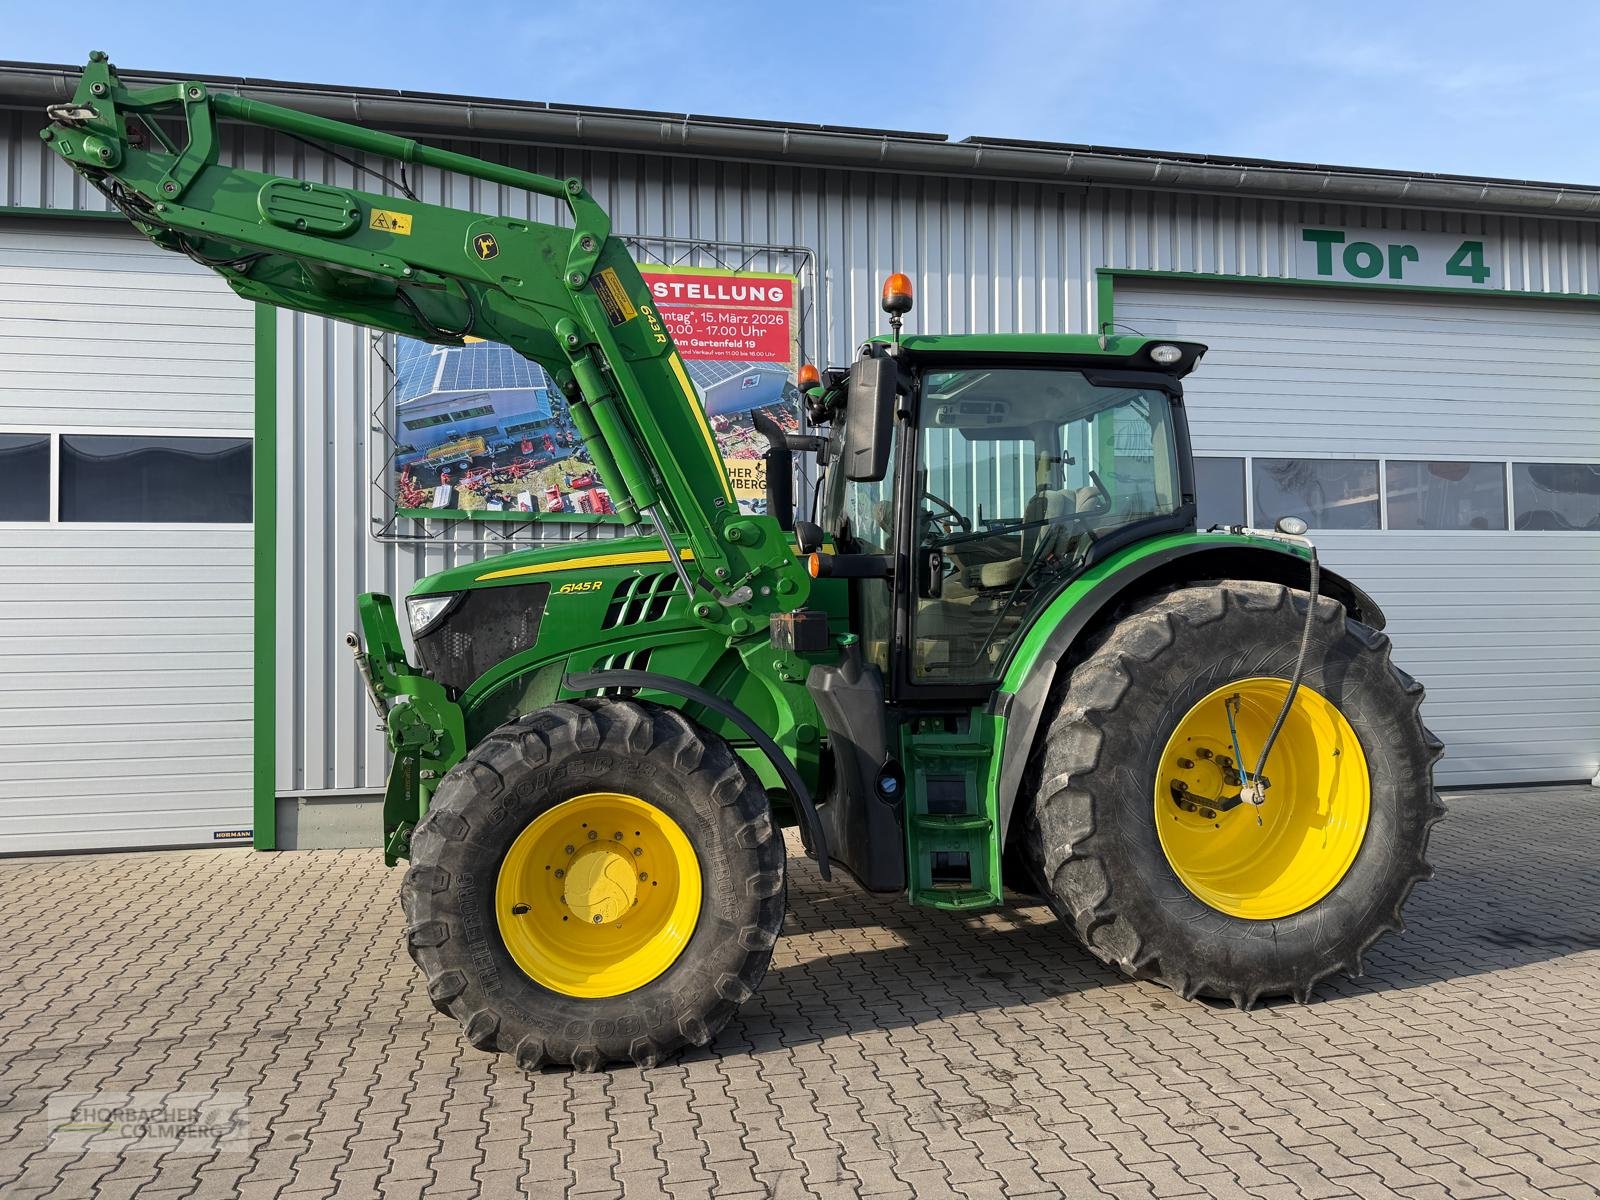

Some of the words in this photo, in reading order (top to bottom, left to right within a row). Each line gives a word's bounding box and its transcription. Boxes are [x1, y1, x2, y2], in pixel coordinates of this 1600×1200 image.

[1302, 228, 1419, 280] Tor
[1446, 240, 1490, 283] 4
[646, 282, 784, 302] STELLUNG
[640, 305, 660, 331] 643
[654, 333, 667, 343] R
[701, 312, 717, 323] 15.
[718, 312, 748, 324] März
[752, 314, 784, 325] 2026
[706, 326, 737, 336] 17.00
[741, 325, 767, 337] Uhr
[674, 338, 688, 346] Am
[690, 338, 742, 348] Gartenfeld
[745, 340, 756, 349] 19
[560, 582, 592, 593] 6145
[592, 581, 603, 591] R
